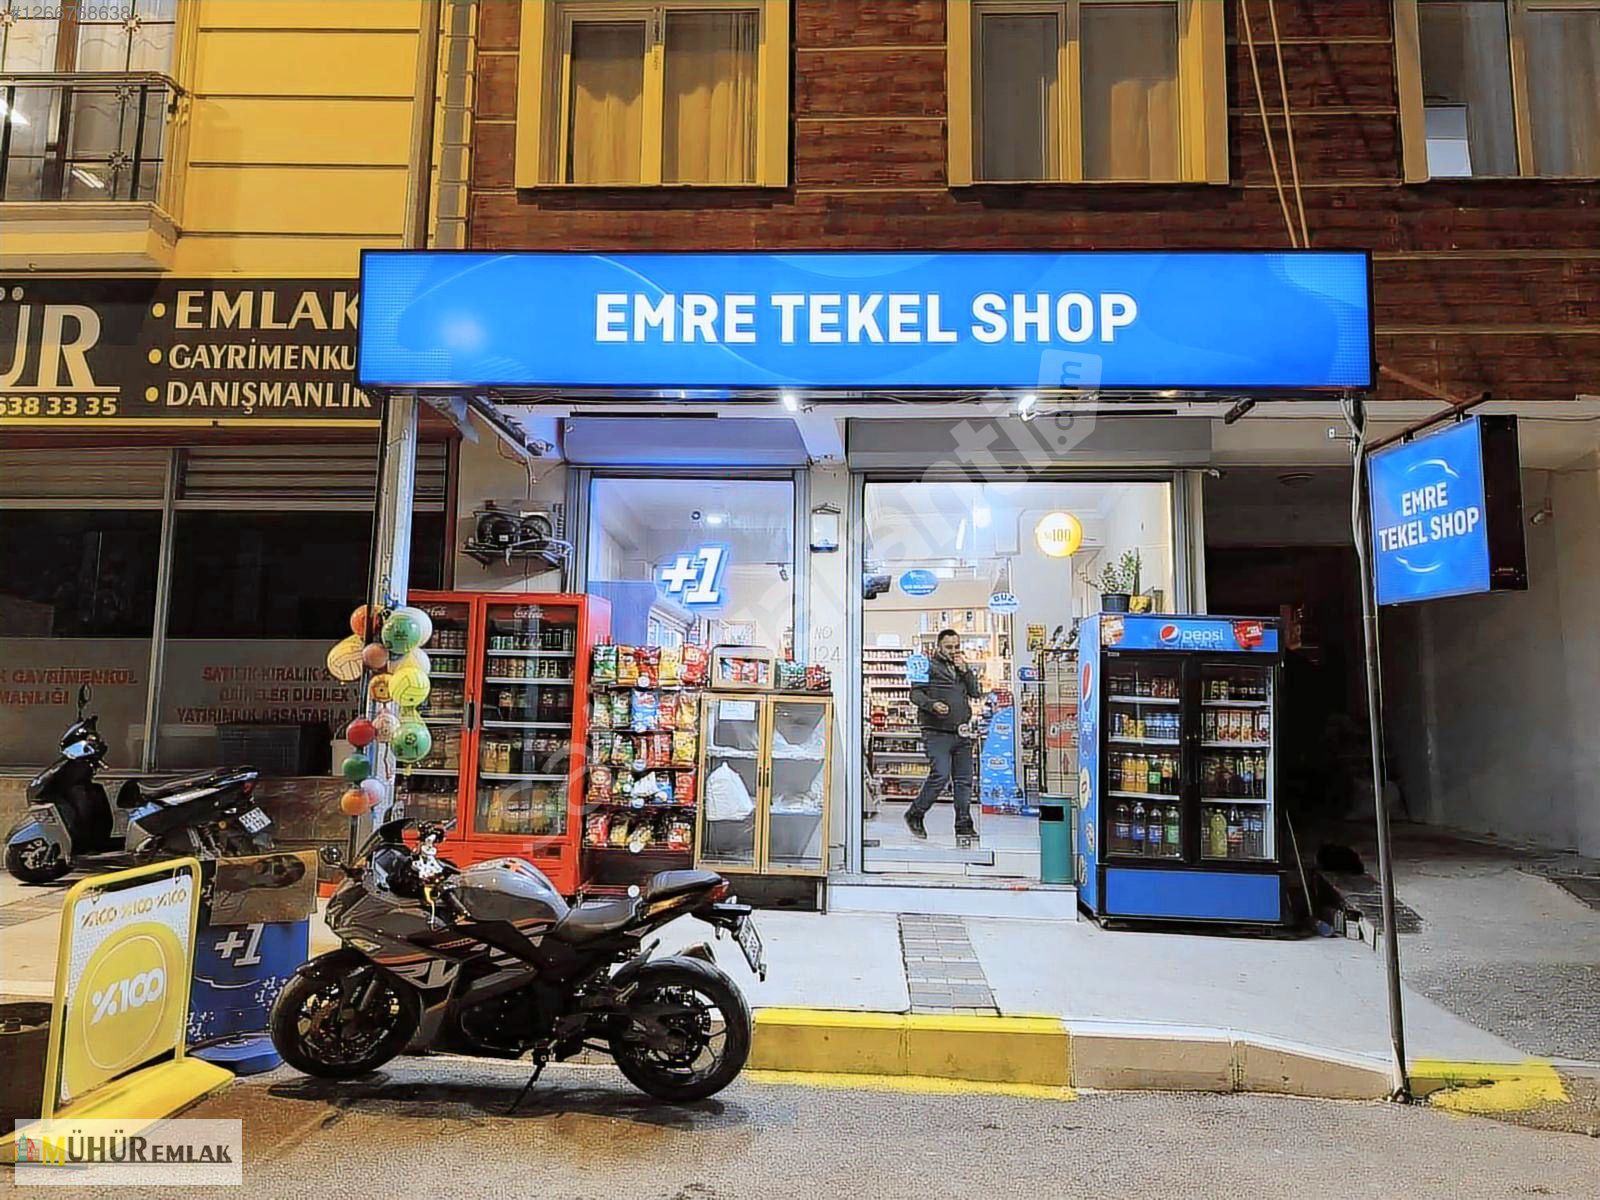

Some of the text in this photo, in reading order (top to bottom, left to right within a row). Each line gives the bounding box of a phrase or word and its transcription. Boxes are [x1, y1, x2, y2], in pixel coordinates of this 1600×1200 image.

[175, 290, 358, 330] EMLAK
[595, 292, 1138, 344] EMRE TEKEL SHOP
[168, 337, 358, 371] GAYRİMENKU
[46, 396, 78, 416] 33
[85, 396, 118, 416] 35
[165, 381, 372, 415] DANIŞMANLIK
[1401, 481, 1449, 517] EMRE
[1378, 506, 1481, 552] TEKEL SHOP
[660, 546, 730, 605] +1
[1181, 628, 1224, 645] pepsi
[213, 922, 265, 967] +1
[90, 966, 164, 1025] %100
